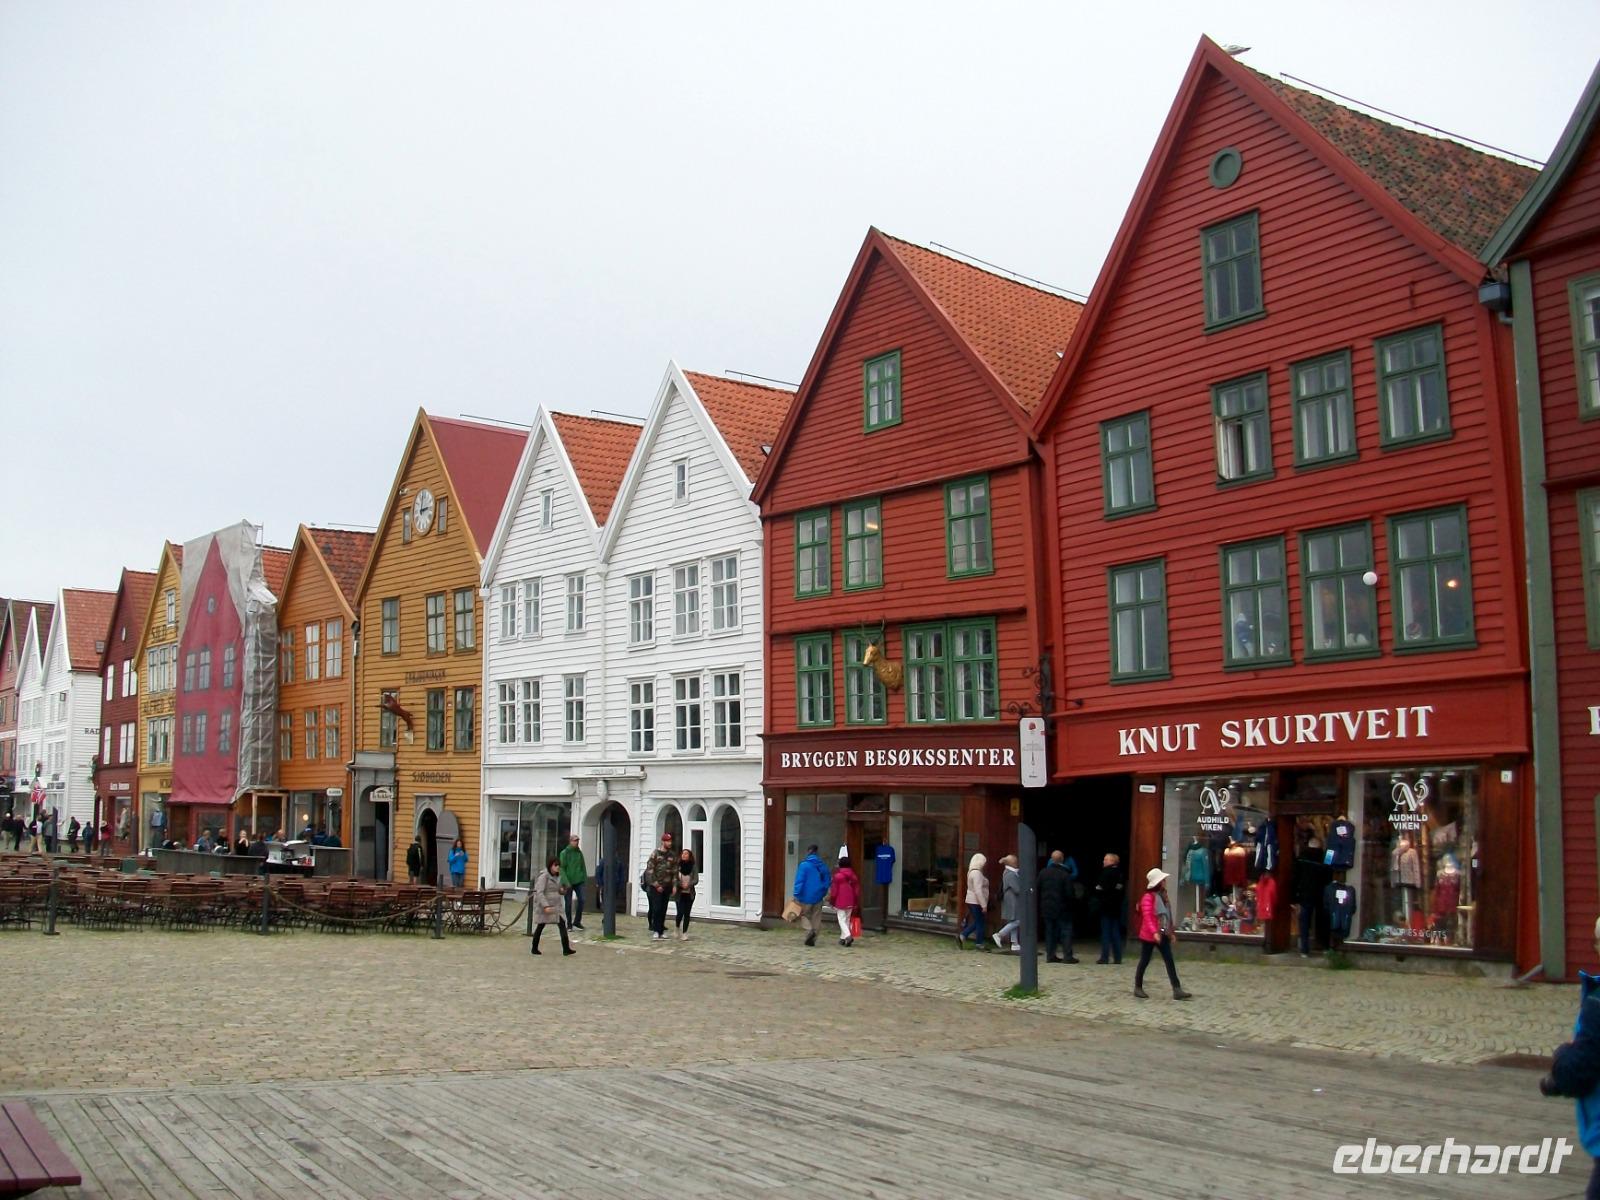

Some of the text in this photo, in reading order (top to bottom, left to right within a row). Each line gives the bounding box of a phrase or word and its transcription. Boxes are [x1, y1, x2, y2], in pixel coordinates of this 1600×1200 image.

[1118, 706, 1433, 756] KNUT SKURTVEIT
[781, 749, 1016, 768] BRYGGEN BESØKSSENTER
[1197, 816, 1230, 824] AUDHILD
[1388, 814, 1429, 822] AUDHILD
[1393, 822, 1420, 830] VIKEN
